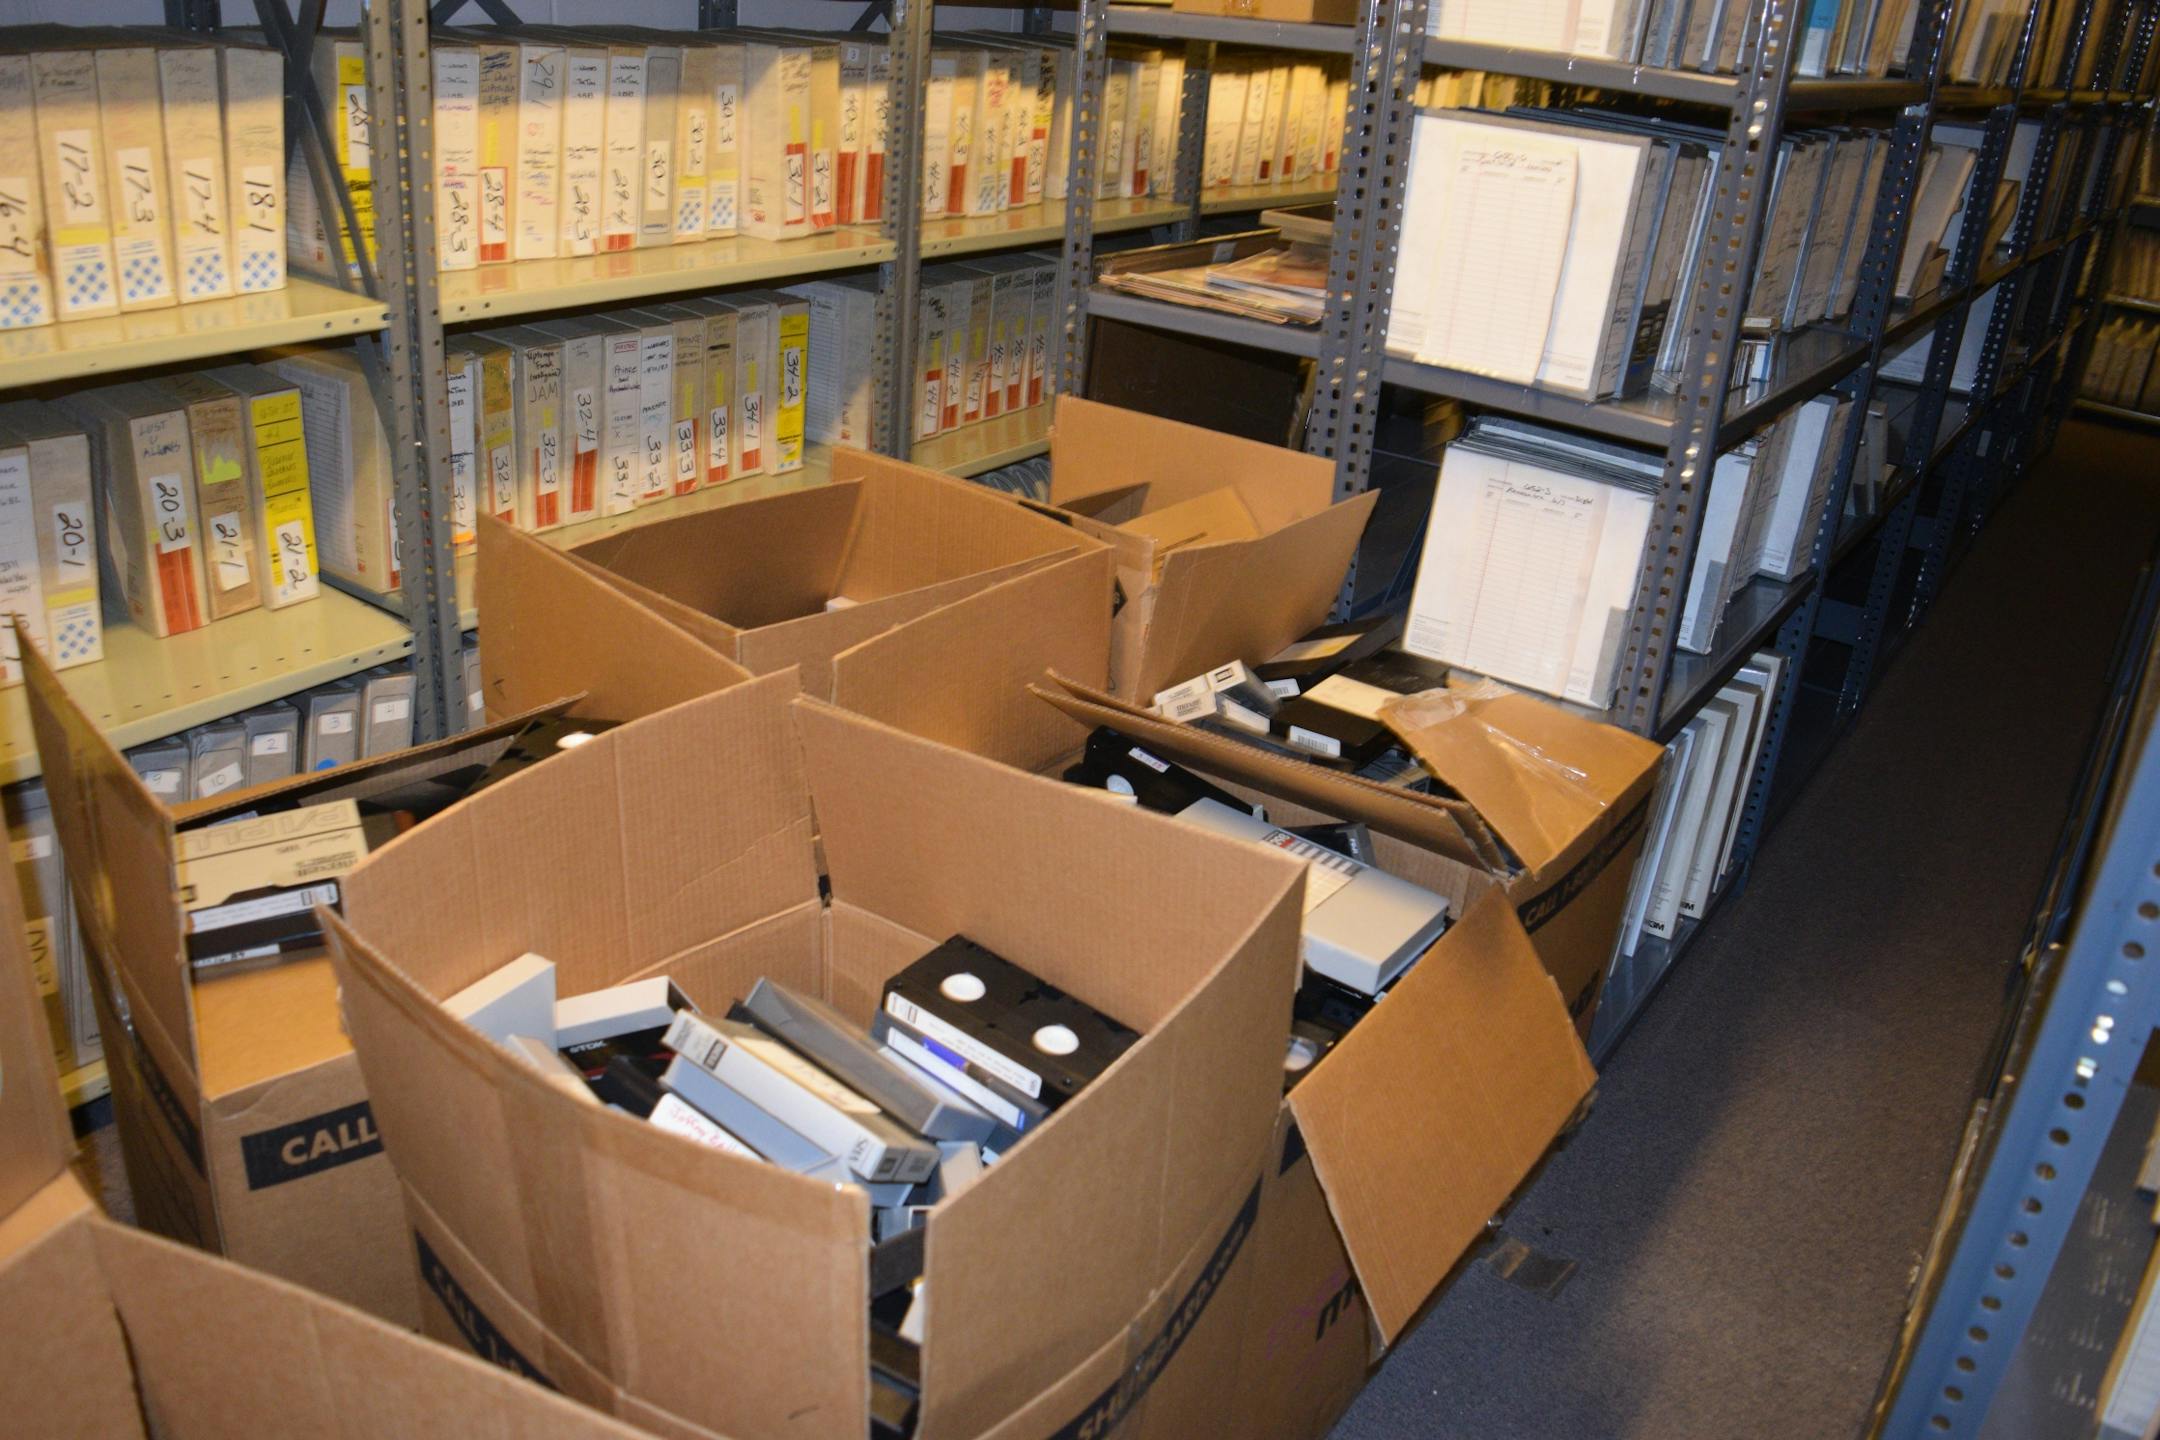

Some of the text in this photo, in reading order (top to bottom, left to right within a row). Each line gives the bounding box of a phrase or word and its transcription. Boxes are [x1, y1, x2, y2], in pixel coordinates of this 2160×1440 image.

[530, 63, 555, 109] 29-1
[720, 92, 734, 144] 30-3
[60, 142, 95, 208] 17-2
[125, 165, 154, 223] 17-3
[787, 158, 803, 206] 31-1
[814, 152, 831, 206] 31-2
[184, 170, 219, 235] 17-4
[245, 180, 276, 232] 18-1
[450, 190, 470, 252] 28-3
[483, 173, 505, 231] 28-4
[529, 382, 558, 403] JAM
[787, 351, 801, 401] 34-2
[577, 394, 599, 447] 32-4
[709, 412, 726, 458] 33-4
[744, 396, 760, 439] 34-1
[541, 432, 557, 485] 32-3
[647, 434, 663, 488] 33-2
[677, 427, 695, 474] 33-3
[613, 456, 629, 497] 33-1
[156, 481, 185, 542] 20-3
[57, 512, 86, 567] 20-1
[215, 522, 243, 567] 21-1
[281, 532, 308, 590] 21-2
[266, 738, 280, 750] 2
[210, 773, 225, 786] 10
[577, 1040, 608, 1053] TDK
[281, 1116, 378, 1166] CALL
[848, 1138, 870, 1163] VHS
